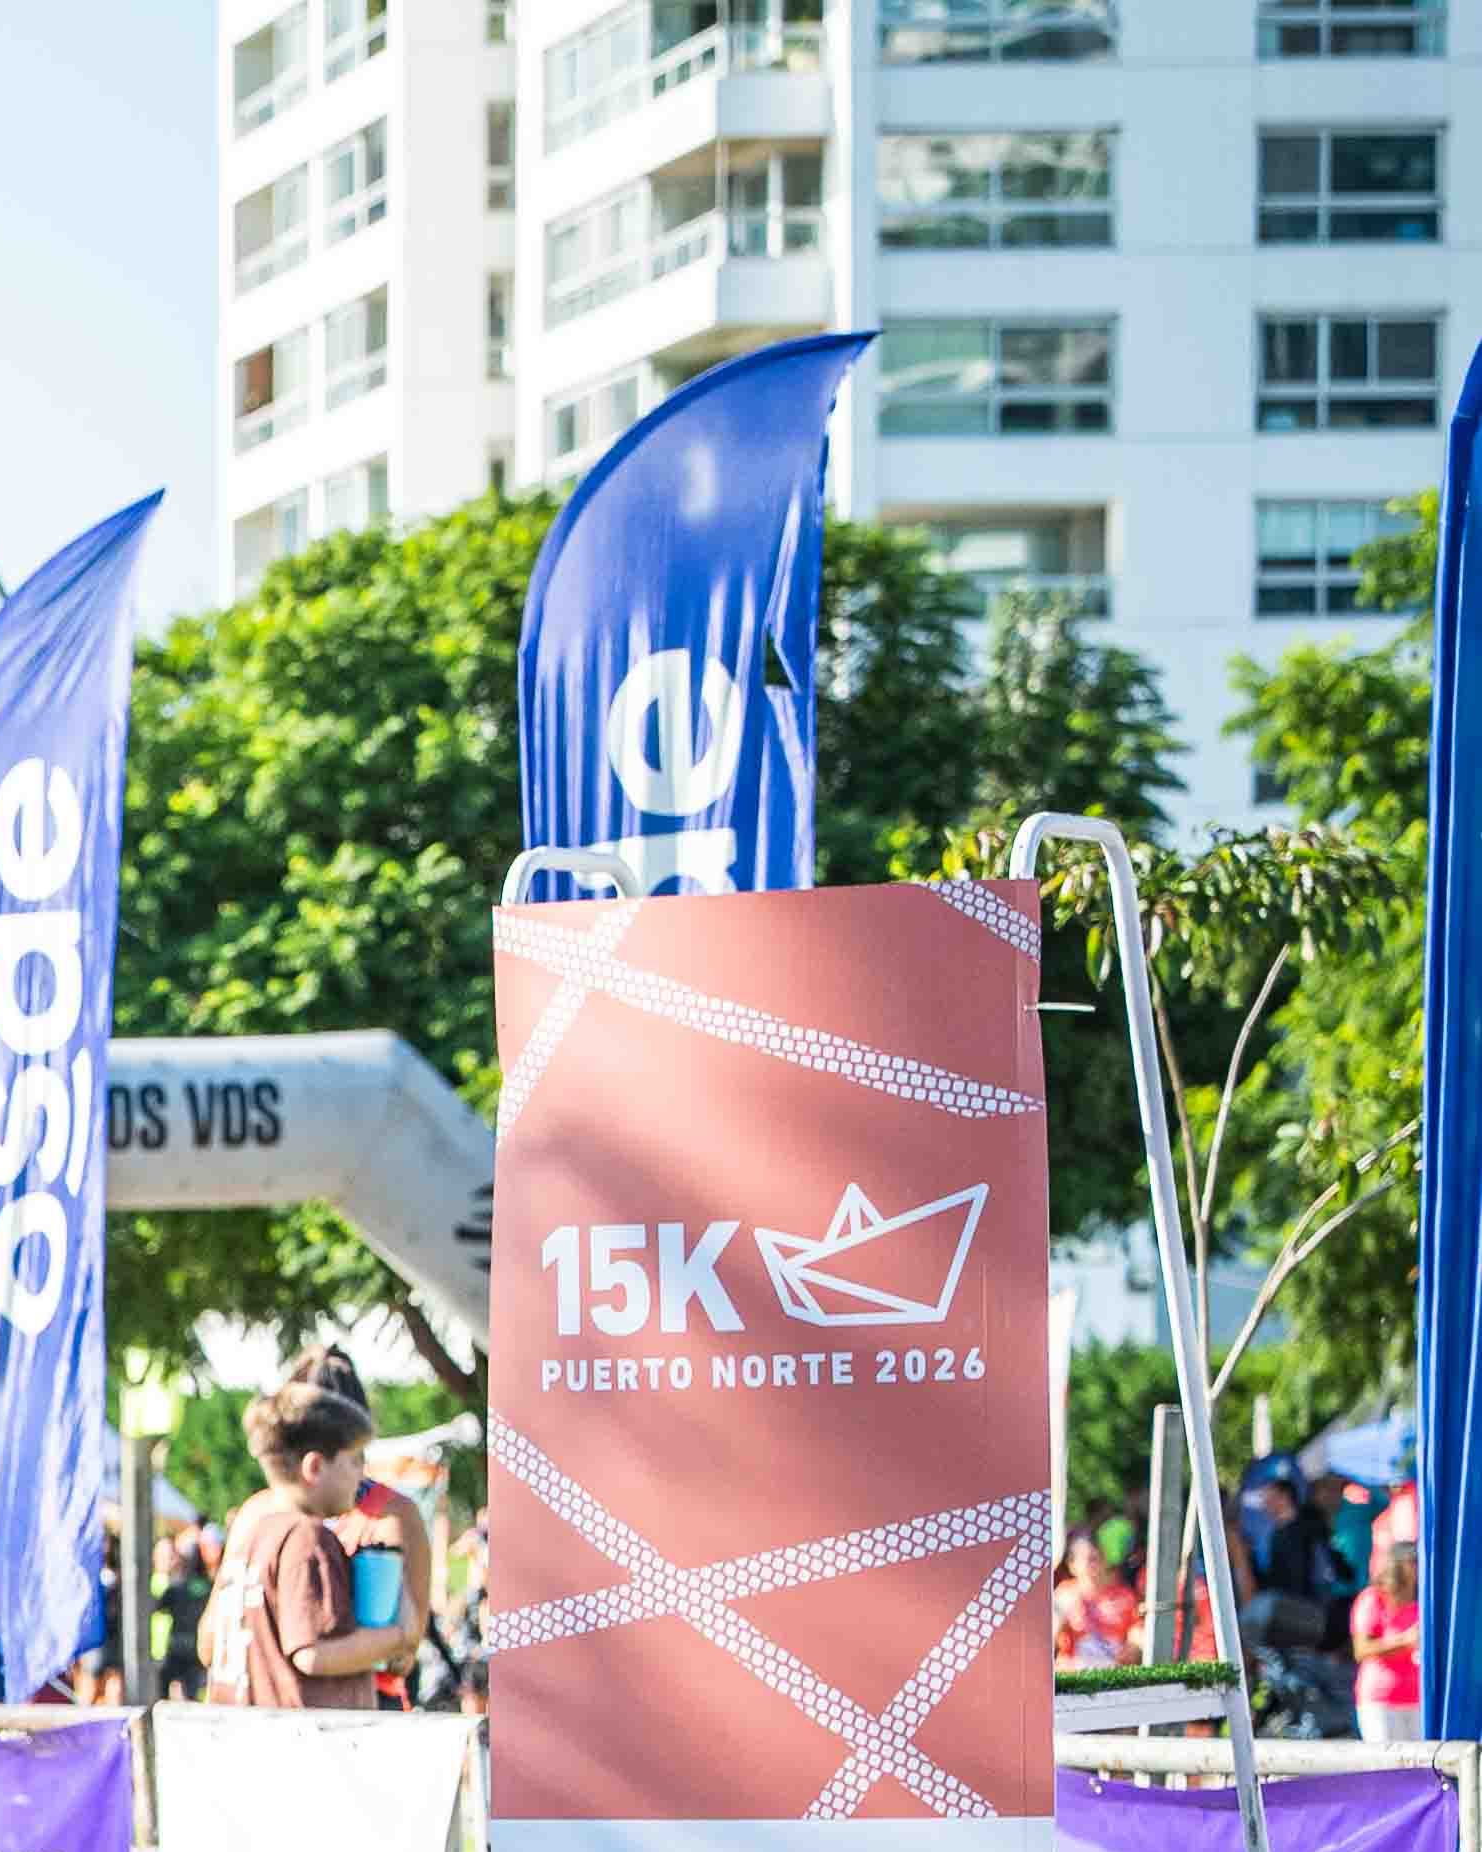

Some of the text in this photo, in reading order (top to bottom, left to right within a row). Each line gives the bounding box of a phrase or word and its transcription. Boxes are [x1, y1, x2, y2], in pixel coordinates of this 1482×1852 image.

[184, 1080, 283, 1146] VOS
[540, 1219, 745, 1337] 15K
[540, 1347, 987, 1392] PUERTO NORTE 2026
